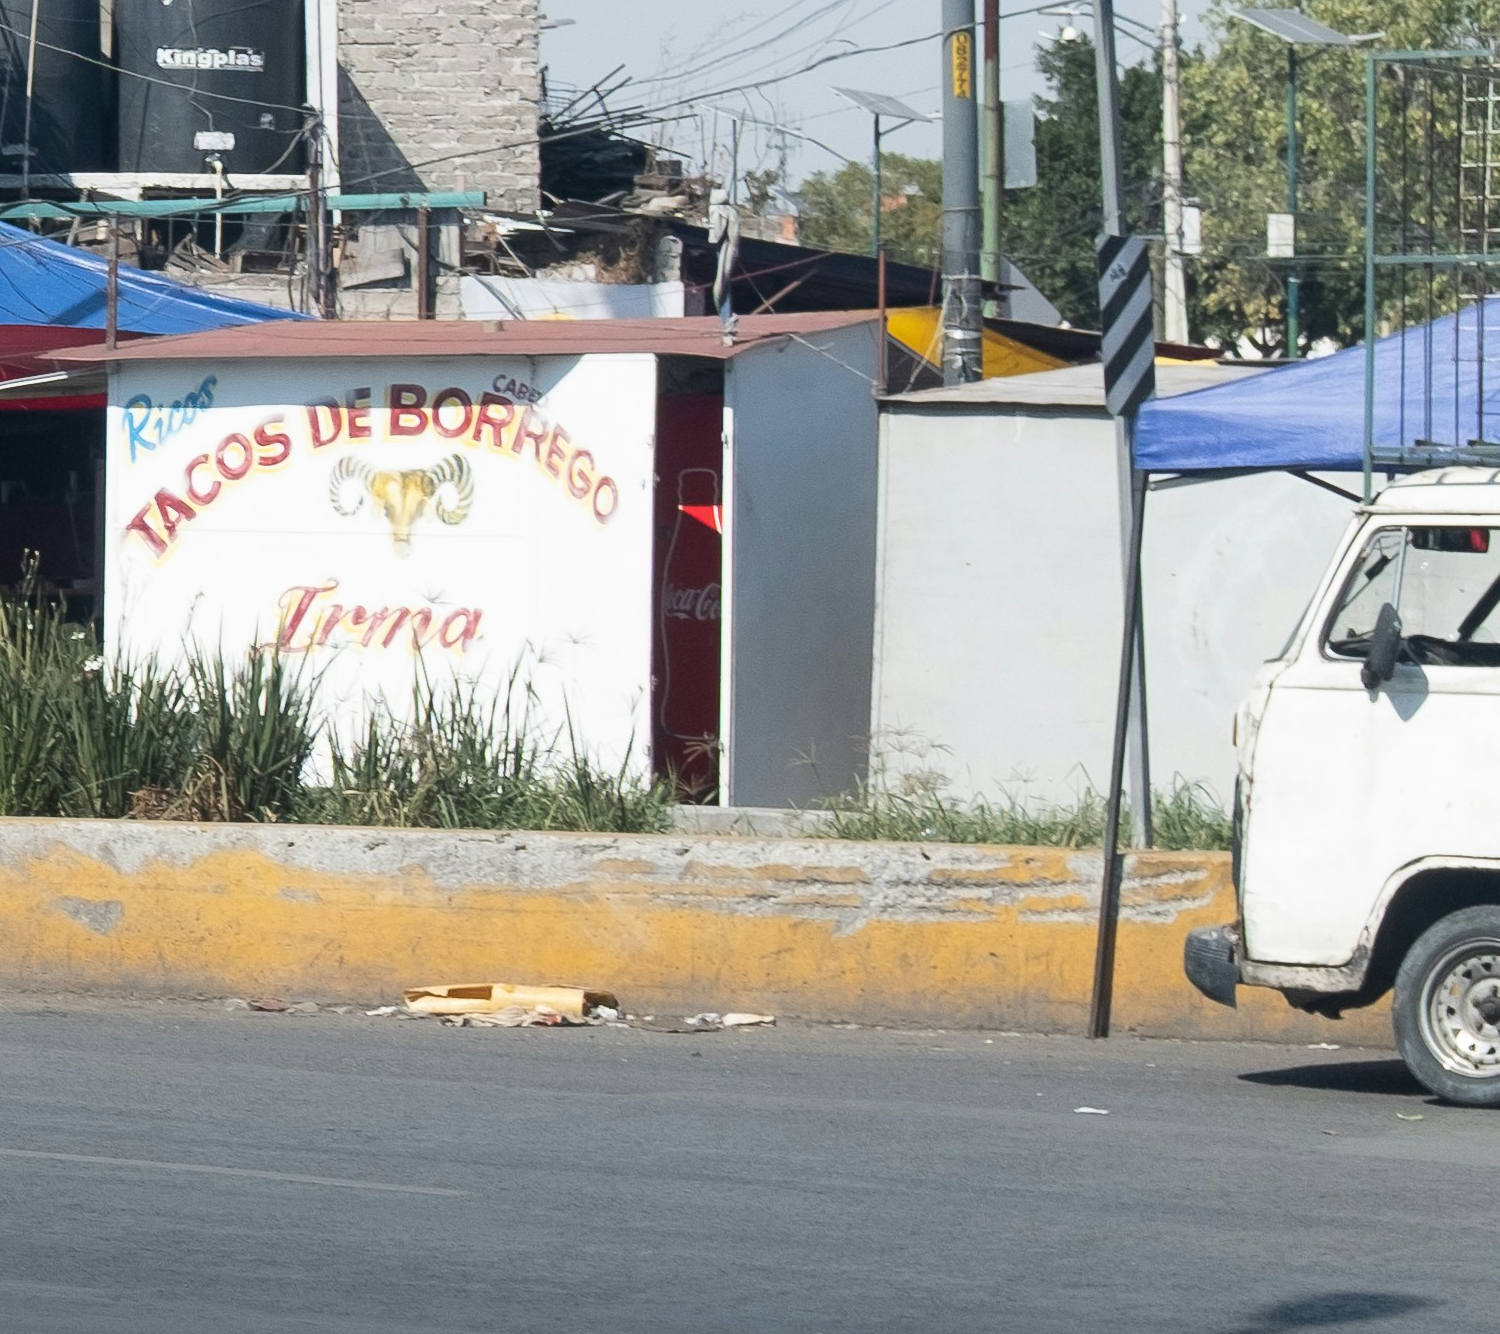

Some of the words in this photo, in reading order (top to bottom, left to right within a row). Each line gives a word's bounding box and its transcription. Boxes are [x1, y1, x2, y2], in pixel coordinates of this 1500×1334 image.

[122, 373, 218, 464] Ricos
[126, 416, 293, 559] TACOS
[306, 386, 372, 448] DE
[389, 383, 619, 524] BORREGO
[262, 578, 483, 653] Irma
